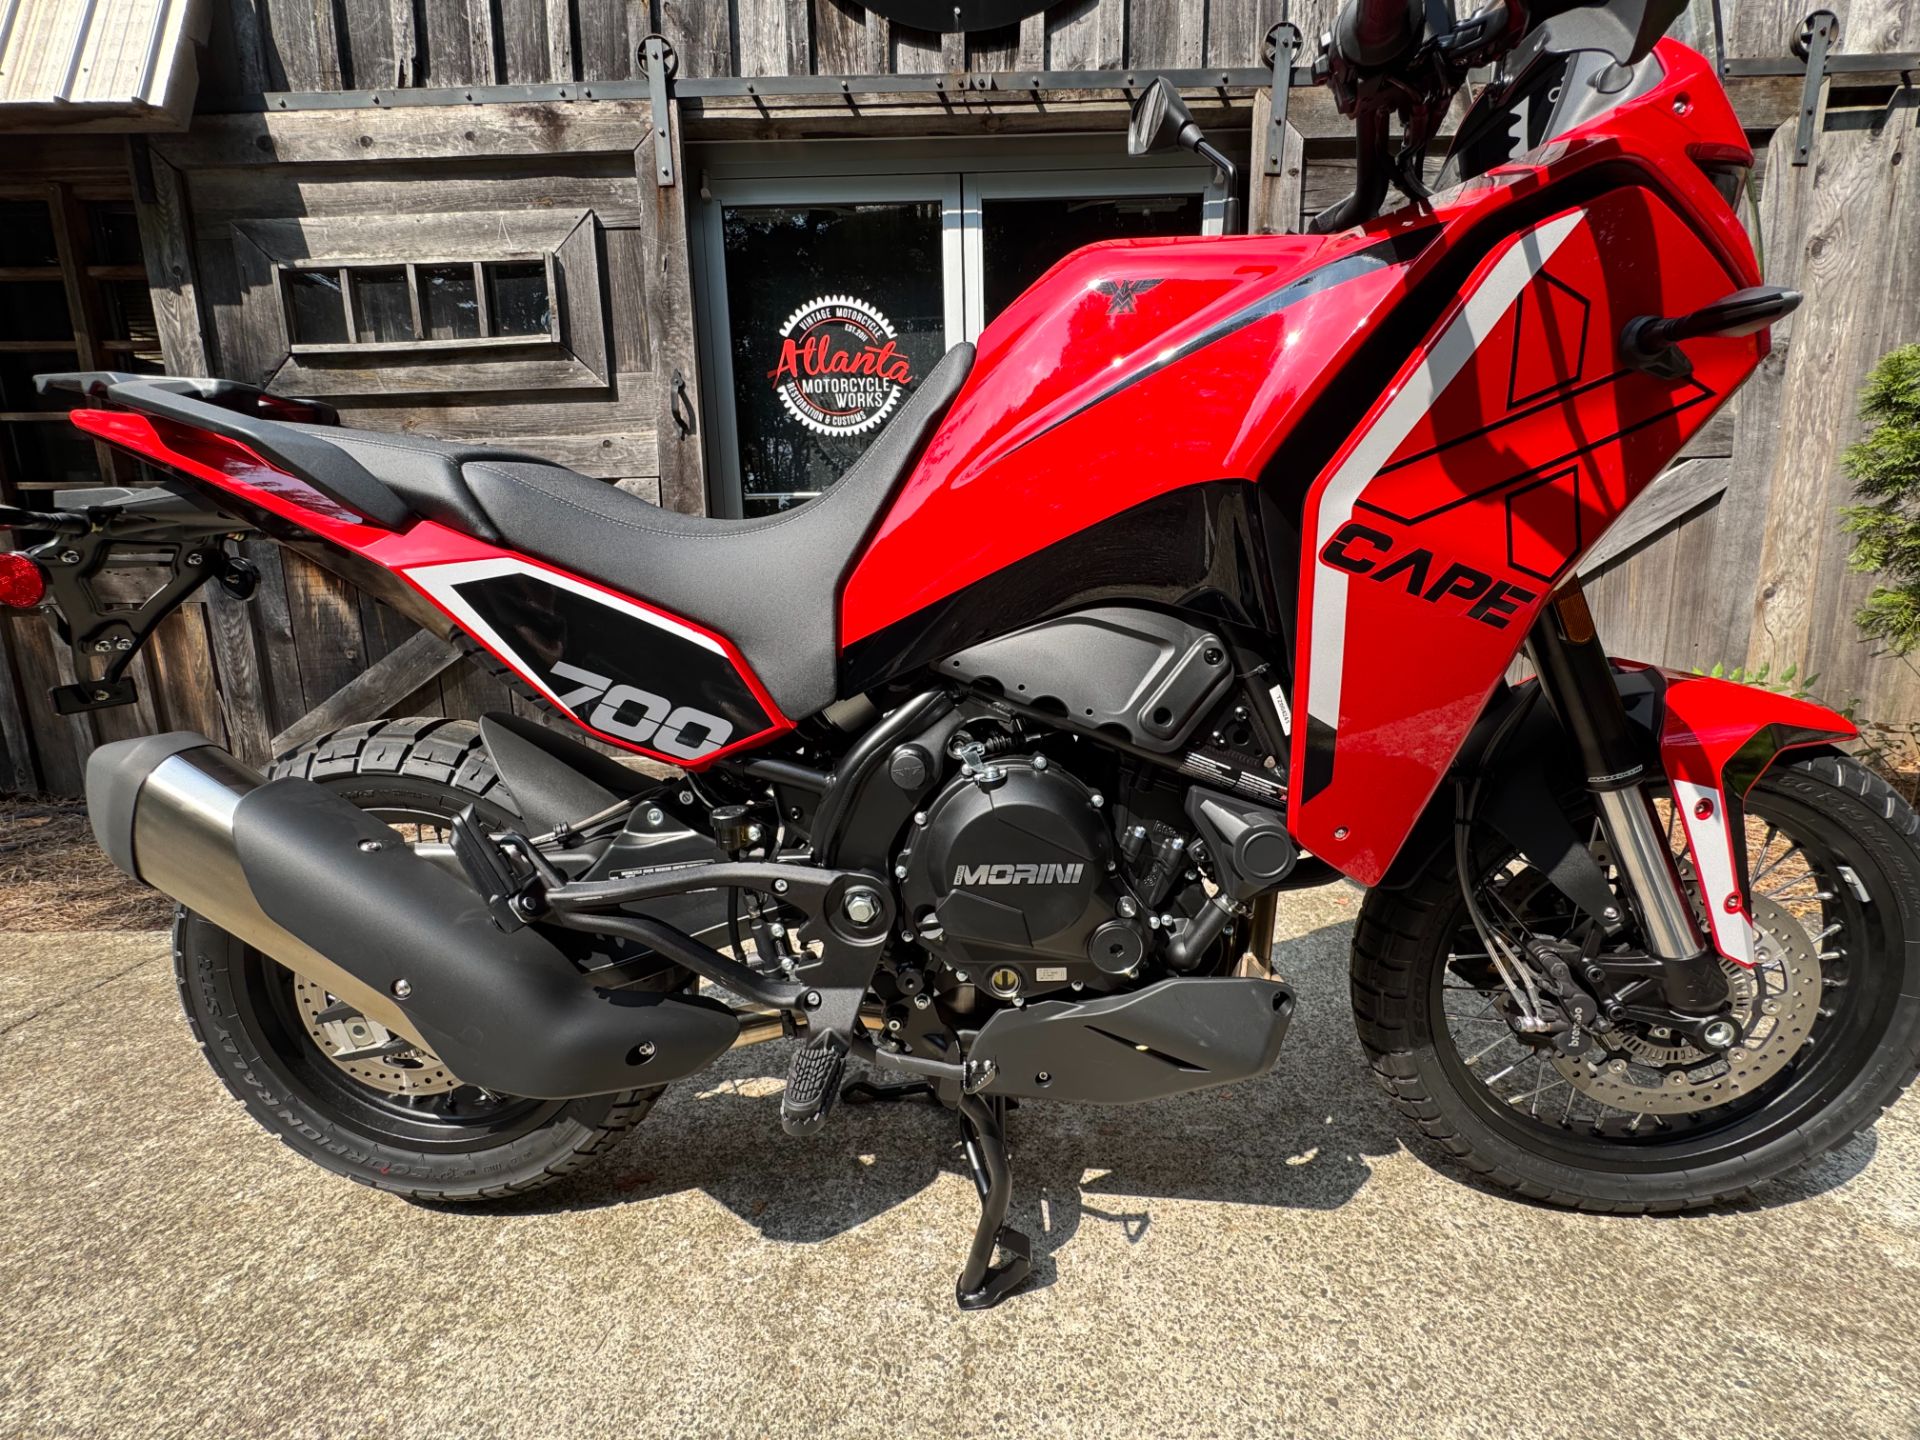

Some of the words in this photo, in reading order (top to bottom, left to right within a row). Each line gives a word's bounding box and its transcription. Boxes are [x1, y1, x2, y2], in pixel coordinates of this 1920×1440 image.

[799, 308, 832, 330] VINTAGE
[836, 307, 883, 339] MOTORCYCLE
[767, 334, 912, 389] Atlanta
[786, 382, 824, 422] RESTORATION
[824, 415, 831, 425] &
[832, 410, 867, 426] CUSTOMS
[802, 377, 890, 394] MOTORCYCLE
[835, 392, 883, 408] WORKS
[1322, 523, 1538, 630] CAPE
[550, 660, 733, 760] 700
[963, 863, 1084, 885] MORINI
[214, 1022, 281, 1107] RALLY
